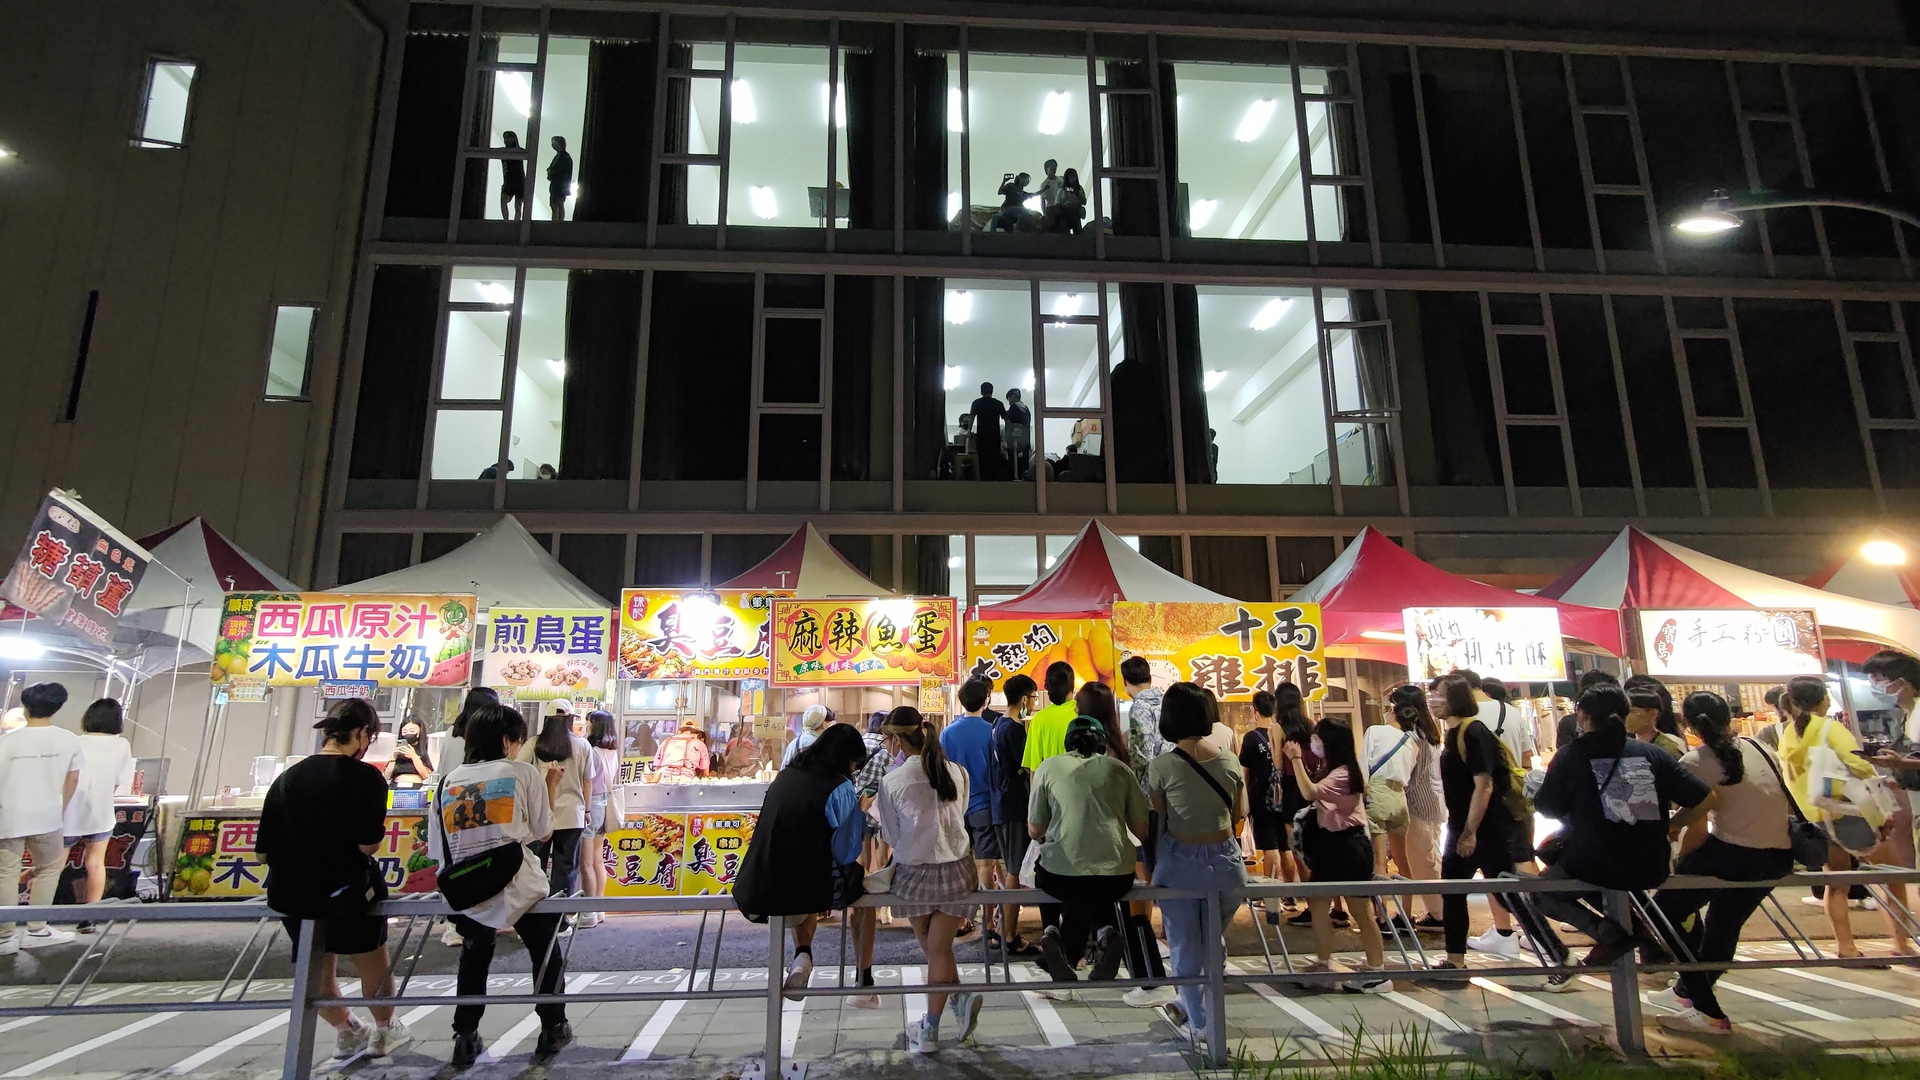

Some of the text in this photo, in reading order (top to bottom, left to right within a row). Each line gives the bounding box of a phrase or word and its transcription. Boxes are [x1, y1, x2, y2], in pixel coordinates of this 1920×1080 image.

[30, 529, 134, 618] 糖葫蘆
[257, 603, 438, 639] 西瓜原汁
[491, 614, 605, 655] 煎鳥蛋
[788, 610, 943, 654] 麻辣魚蛋
[1688, 615, 1797, 648] 手工粉圓
[1657, 624, 1676, 659] 寶島
[249, 642, 431, 680] 木瓜牛奶
[799, 660, 822, 674] 原味
[829, 659, 852, 674] 辣味
[859, 660, 881, 674] 綜合
[1190, 655, 1322, 698] 雞排
[325, 685, 370, 697] 西瓜牛奶
[603, 837, 680, 890] 臭豆腐
[592, 974, 682, 986] 047
